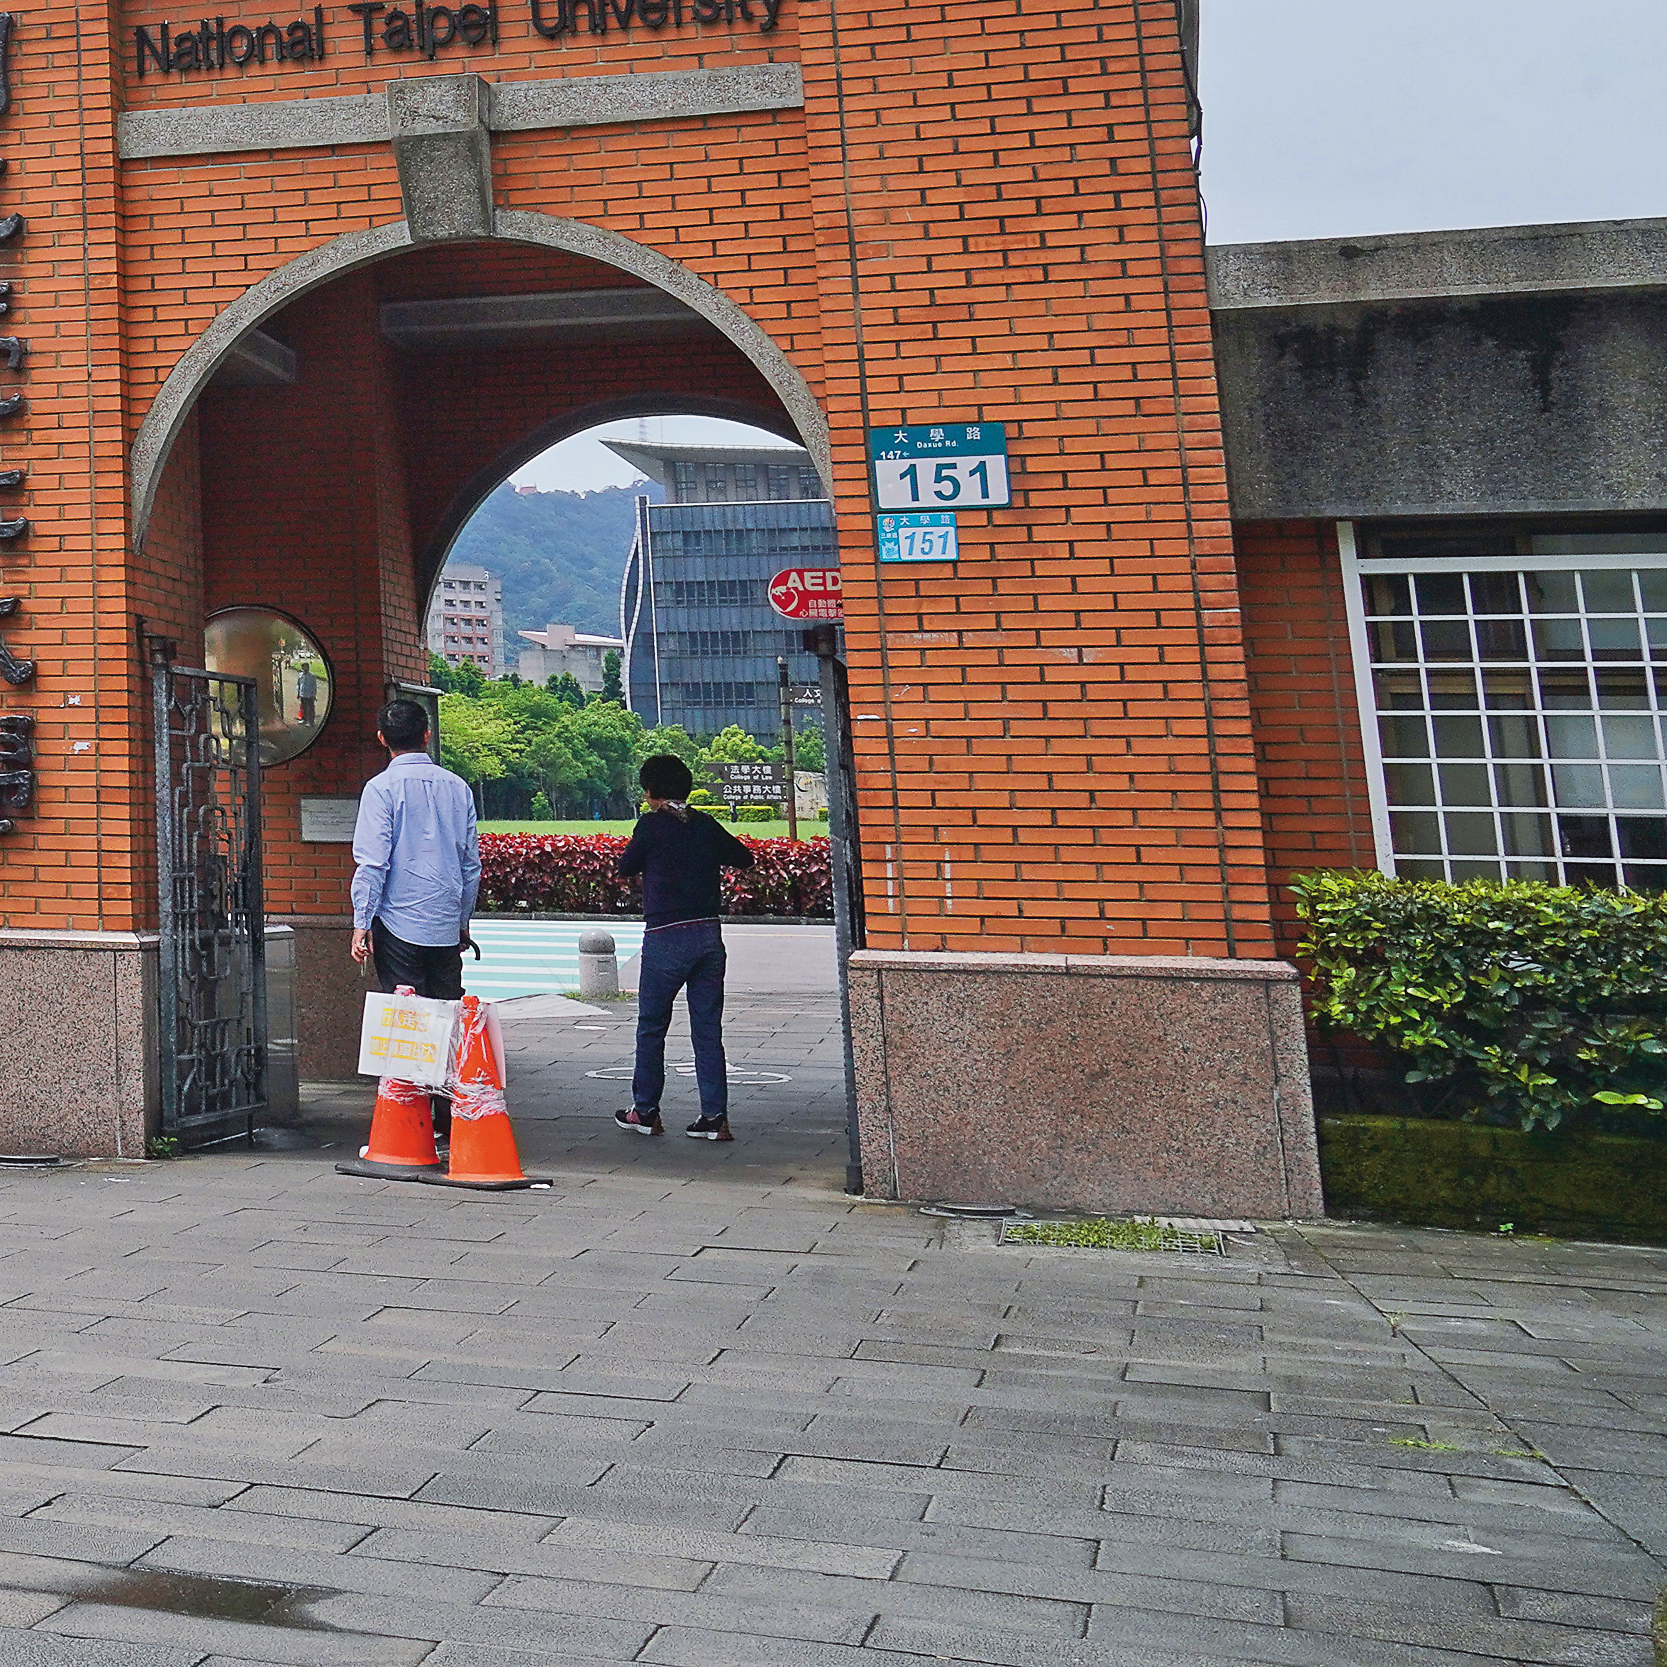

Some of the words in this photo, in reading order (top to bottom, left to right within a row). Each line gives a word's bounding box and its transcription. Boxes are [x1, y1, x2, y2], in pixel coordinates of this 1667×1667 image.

[134, 3, 324, 78] National
[894, 427, 981, 443] 大學路
[880, 450, 901, 460] 147
[899, 460, 989, 502] 151
[900, 515, 950, 526] 大學路
[904, 531, 950, 556] 151
[787, 571, 842, 591] AED
[730, 765, 772, 774] 法學大樓
[723, 784, 782, 794] 公共事務大樓
